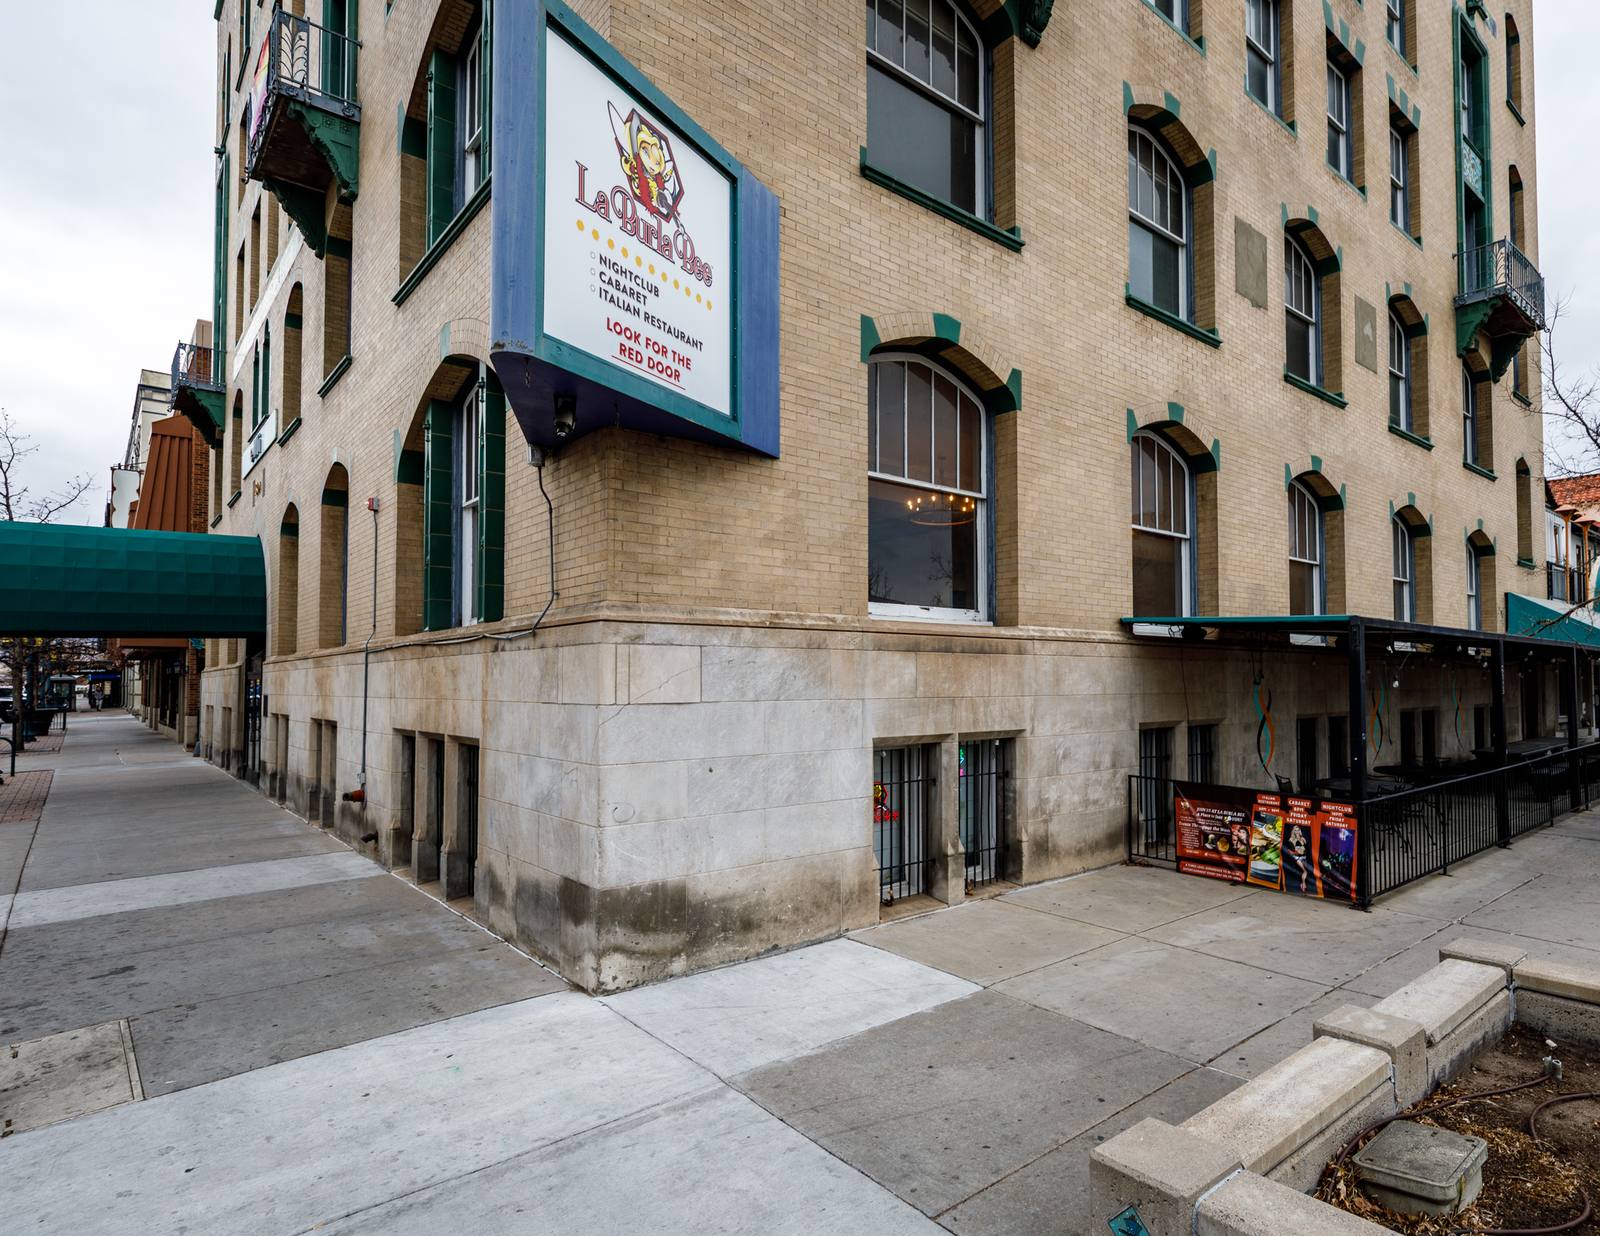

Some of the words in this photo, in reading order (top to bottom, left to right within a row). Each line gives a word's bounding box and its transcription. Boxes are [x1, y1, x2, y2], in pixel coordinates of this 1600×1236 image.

[575, 160, 612, 223] La
[610, 185, 675, 264] Burla
[673, 228, 712, 287] Bee
[599, 253, 660, 298] NIGHTCLUB
[599, 271, 648, 306] CABARET
[599, 287, 641, 319] ITALIAN
[643, 311, 704, 352] RESTAURANT
[606, 317, 641, 346] LOOK
[645, 336, 668, 359] FOR
[671, 350, 692, 371] THE
[619, 343, 643, 364] RED
[647, 356, 681, 383] DOOR
[1286, 817, 1311, 825] SATURDAY
[1322, 804, 1352, 812] NIGHTCLUB
